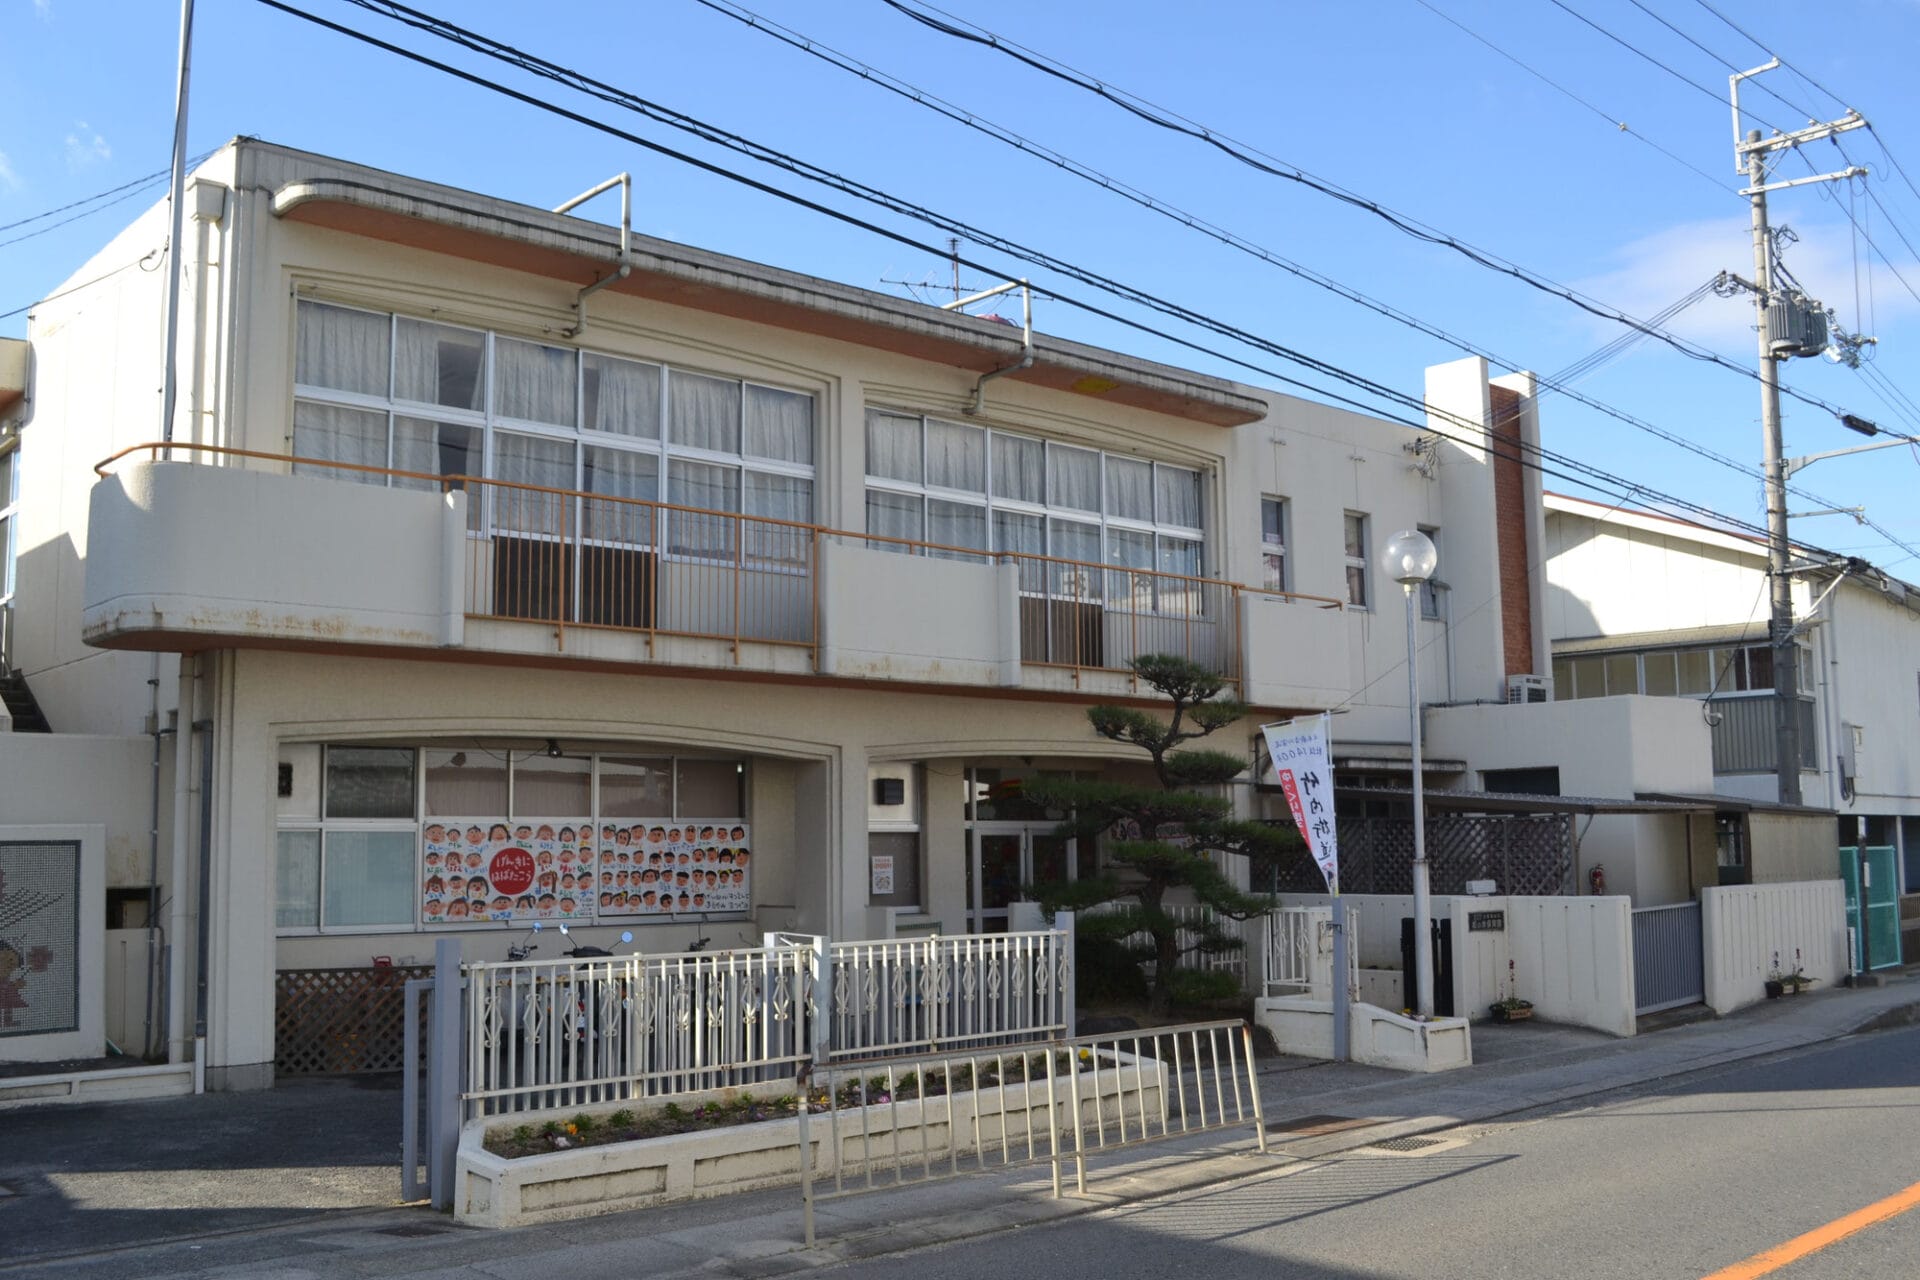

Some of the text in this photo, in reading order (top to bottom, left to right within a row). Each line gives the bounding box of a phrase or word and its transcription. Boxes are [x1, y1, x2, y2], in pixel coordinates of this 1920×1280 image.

[496, 854, 531, 869] げんきに
[491, 869, 532, 882] はばたこう
